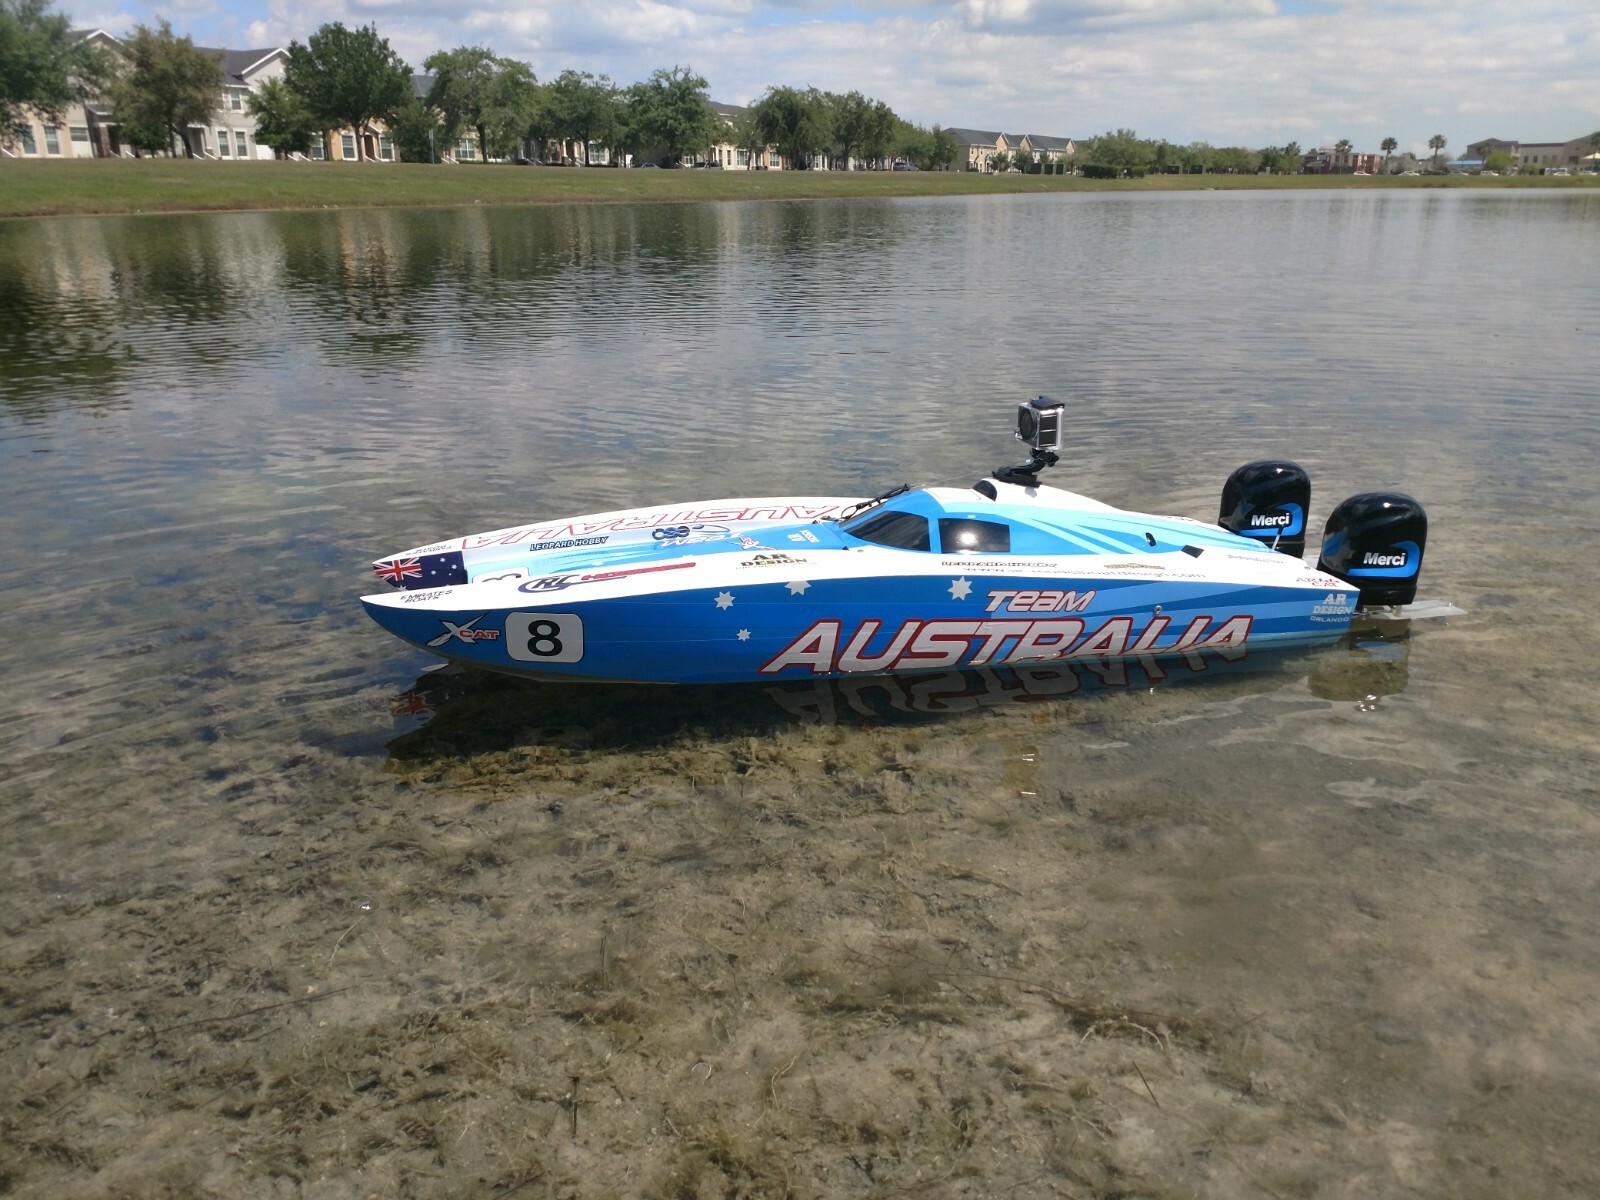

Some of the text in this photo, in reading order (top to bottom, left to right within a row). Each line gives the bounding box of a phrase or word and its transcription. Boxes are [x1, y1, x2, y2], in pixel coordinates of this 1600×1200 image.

[1251, 512, 1290, 526] Merci
[530, 536, 609, 552] LEOPARD HOBBY
[740, 558, 808, 567] DESIGN
[752, 553, 790, 561] AR
[1363, 552, 1405, 566] Merci
[400, 589, 453, 601] EMIRATES
[1322, 593, 1347, 605] AR
[1311, 605, 1352, 615] DESIGN
[1310, 615, 1350, 623] ORLANDO
[527, 619, 563, 657] 8
[758, 615, 1253, 676] AUSTRALIA
